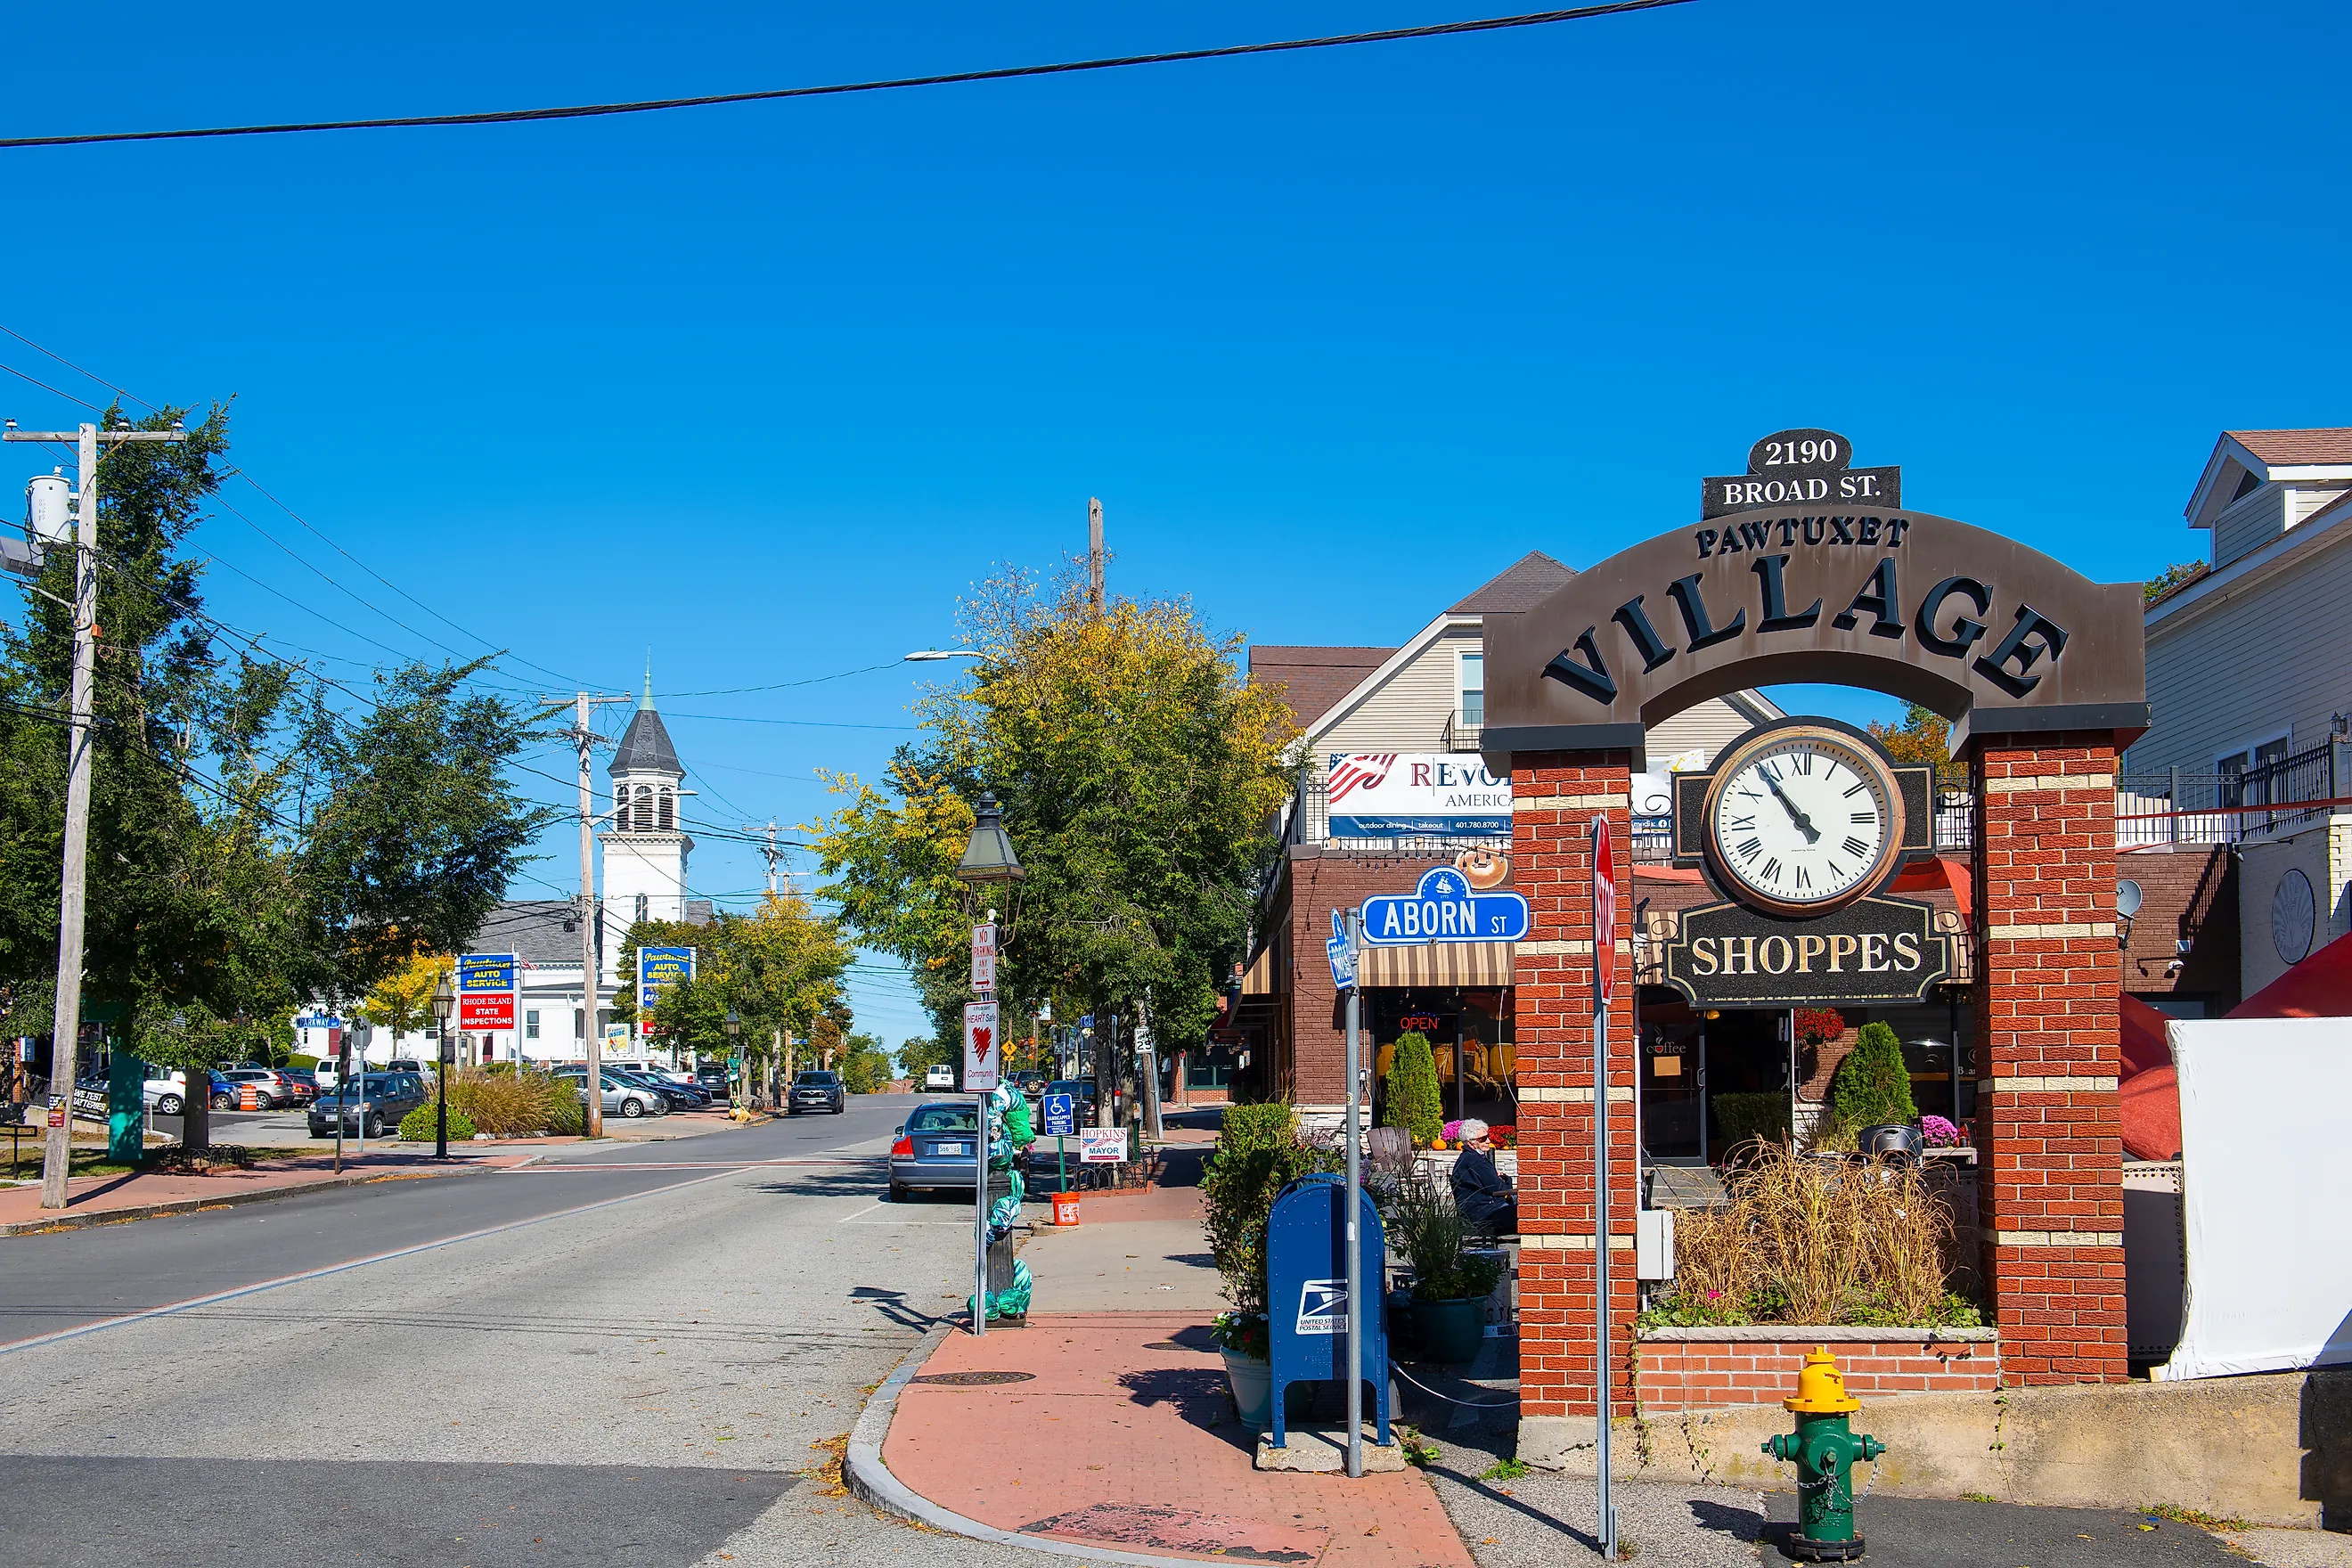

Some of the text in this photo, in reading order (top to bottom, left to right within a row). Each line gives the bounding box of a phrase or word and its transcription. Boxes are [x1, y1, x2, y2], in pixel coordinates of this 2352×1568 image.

[1765, 439, 1837, 465] 2190
[1723, 475, 1882, 504] BROAD ST.
[1695, 516, 1910, 559] PAWTUXET
[1539, 552, 2070, 706] VILLAGE
[1597, 871, 1614, 947] STOP
[1383, 900, 1507, 935] ABORN ST
[978, 930, 988, 943] NO
[974, 944, 993, 958] PARKING
[1692, 933, 1921, 976] SHOPPES
[979, 959, 988, 968] ANY
[474, 970, 501, 978] AUTO
[978, 968, 989, 977] TIME
[466, 979, 508, 987] SERVICE
[299, 1018, 329, 1026] PARKWAY
[967, 1012, 996, 1024] HEART Safe
[1400, 1017, 1438, 1030] OPEN
[1137, 1041, 1152, 1050] 25
[74, 1089, 104, 1102] WE TEST
[1082, 1129, 1126, 1138] HOPKINS
